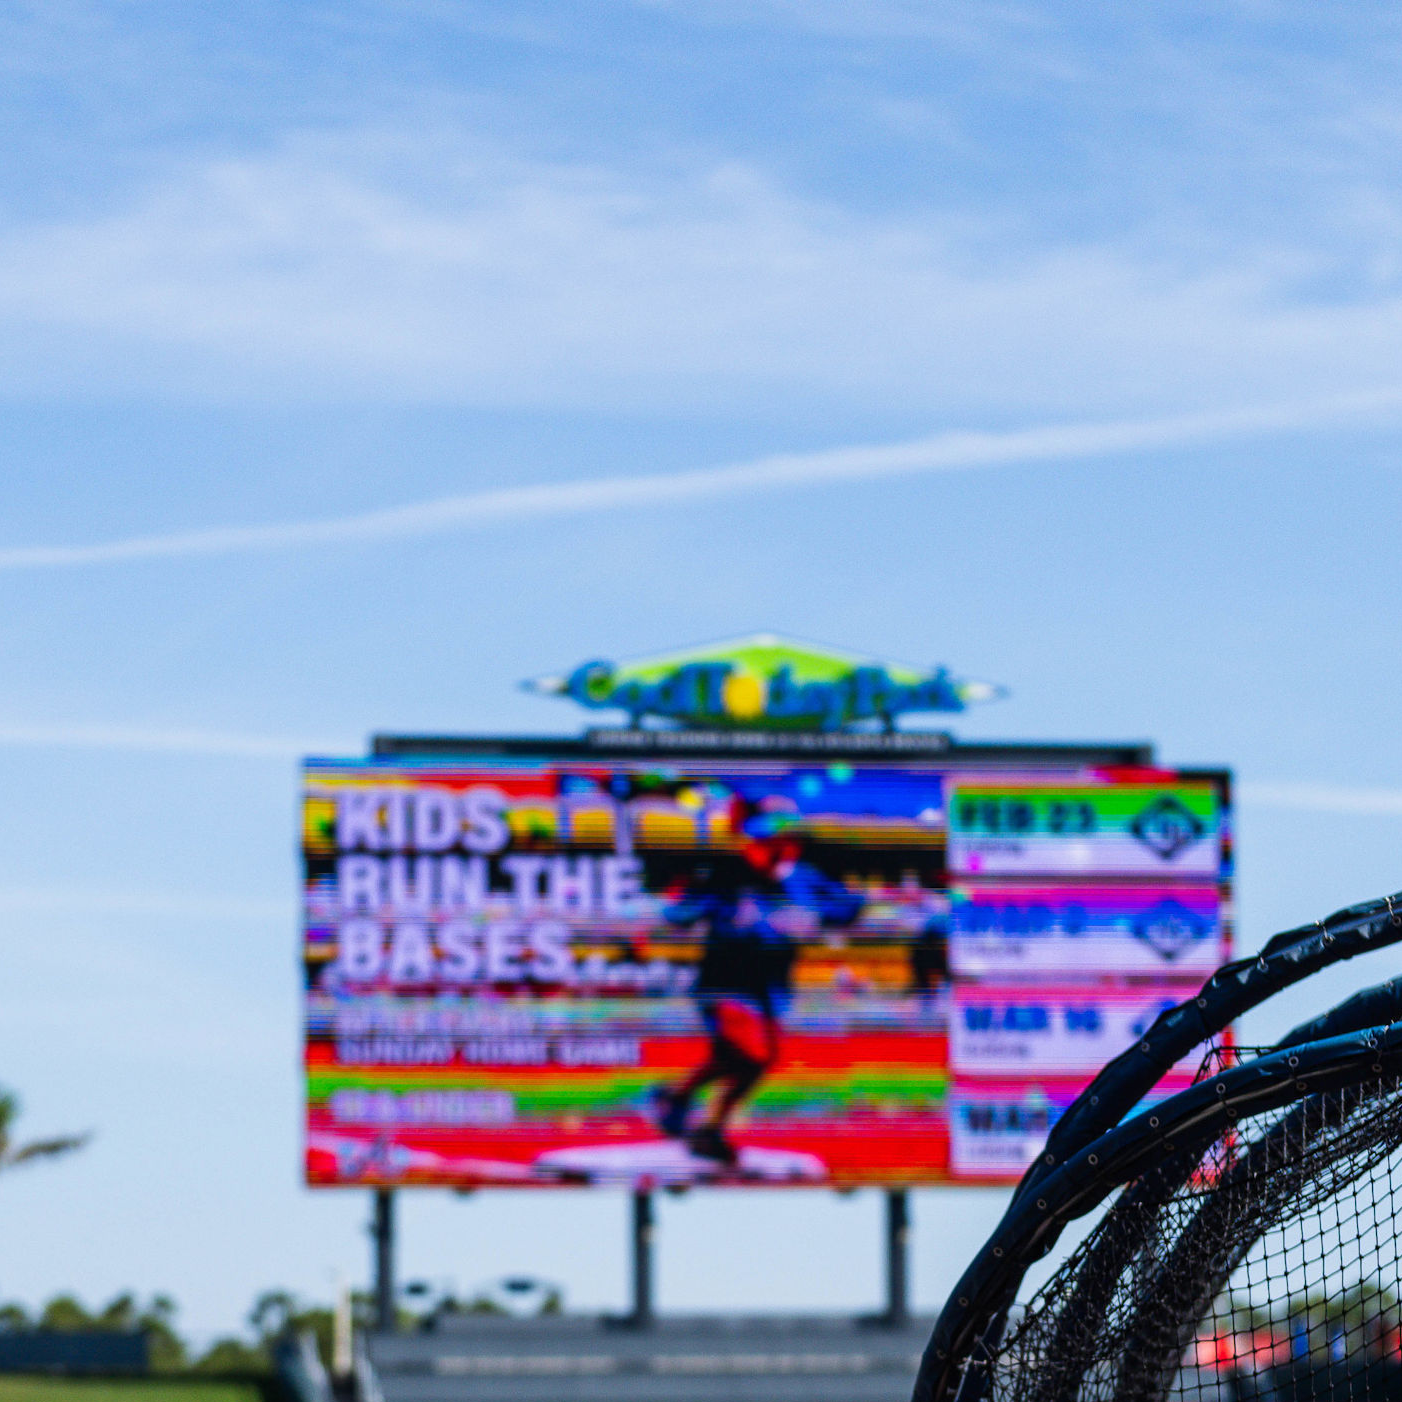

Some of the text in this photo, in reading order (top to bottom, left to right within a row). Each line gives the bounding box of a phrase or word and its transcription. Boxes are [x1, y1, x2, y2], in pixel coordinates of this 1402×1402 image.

[336, 783, 510, 851] KIDS
[336, 855, 644, 914] RUN THE
[336, 920, 572, 982] BASES
